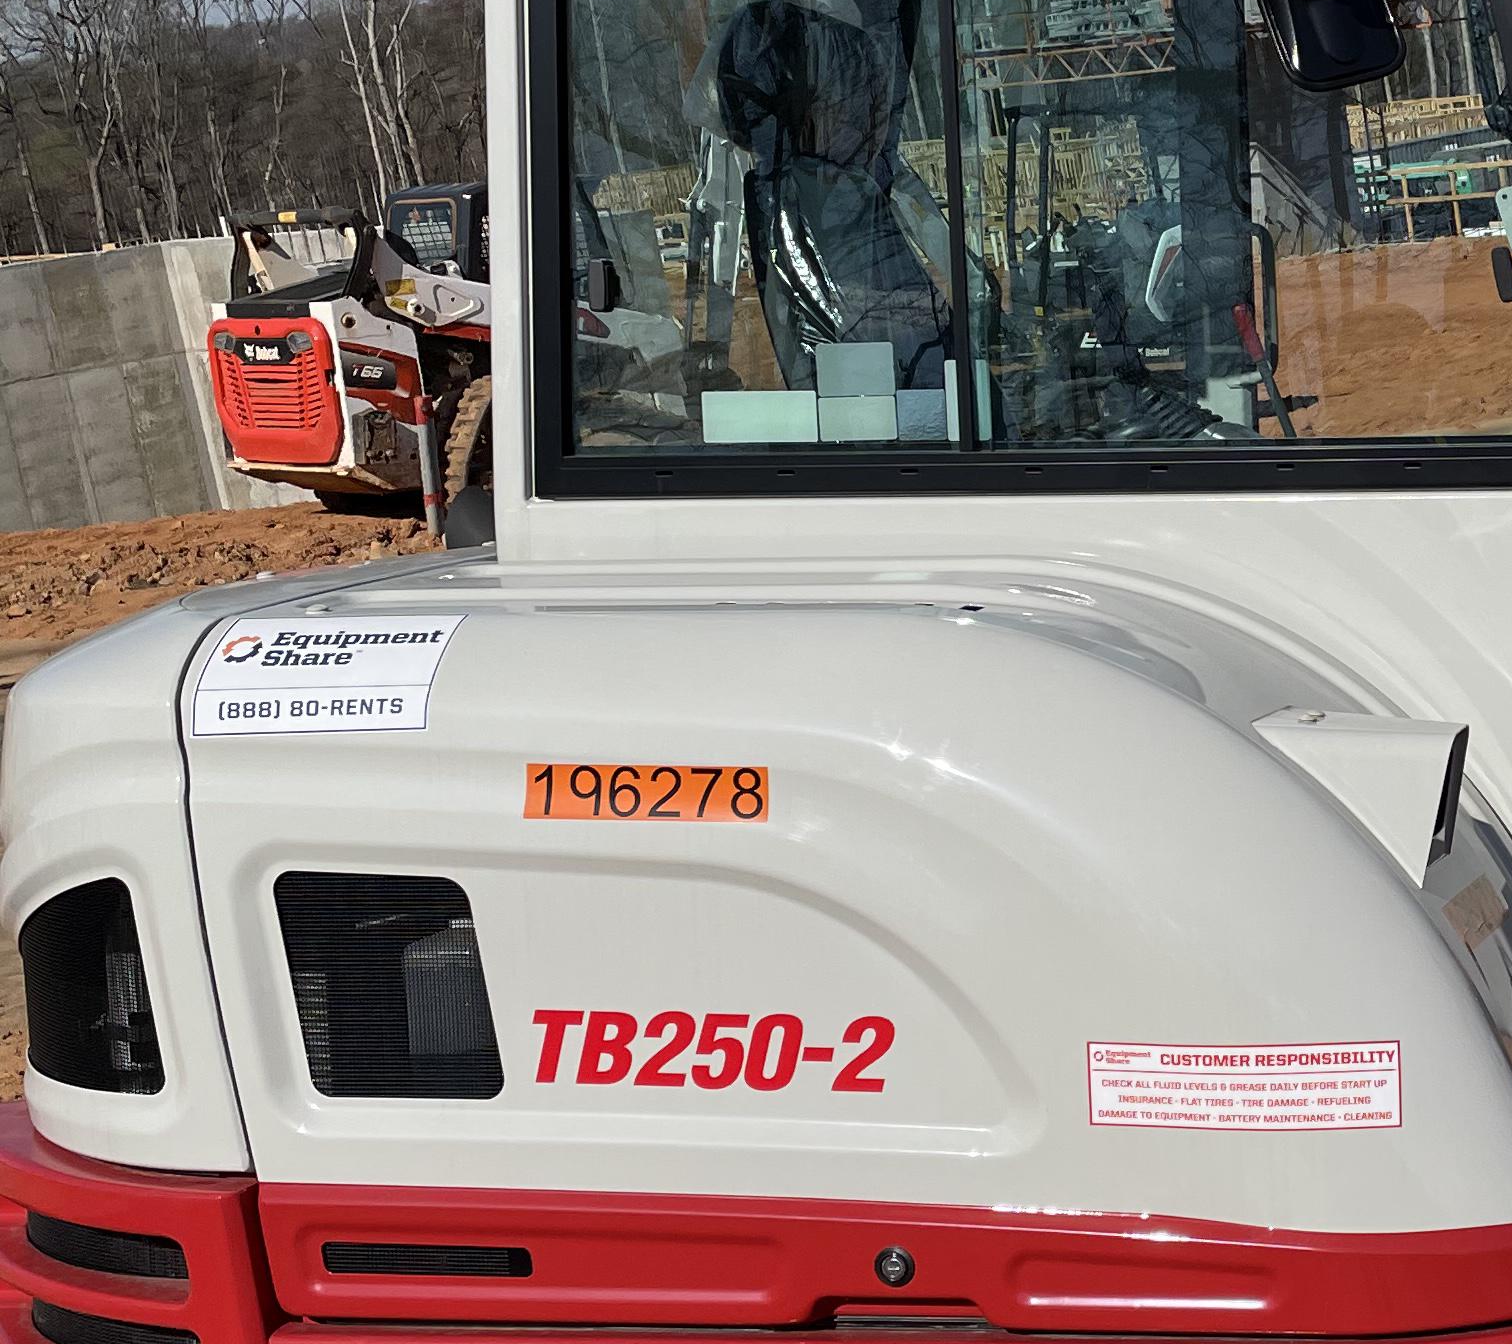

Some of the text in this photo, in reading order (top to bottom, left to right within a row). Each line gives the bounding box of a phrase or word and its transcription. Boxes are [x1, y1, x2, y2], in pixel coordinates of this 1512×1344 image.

[270, 629, 444, 650] Equipment
[261, 649, 353, 667] Share
[218, 698, 404, 721] (888) 80-RENTS
[532, 766, 764, 819] 196278
[532, 1009, 896, 1093] TB250-2
[1160, 1050, 1395, 1067] CUSTOMER RESPONSIBILITY
[1102, 1079, 1134, 1088] CHECK
[1153, 1081, 1181, 1090] FLUID
[1184, 1082, 1217, 1091] LEVELS
[1230, 1083, 1267, 1091] GREASE
[1270, 1082, 1299, 1091] DAILY
[1301, 1081, 1338, 1090] BEFORE
[1341, 1080, 1371, 1089] START
[1119, 1095, 1371, 1107] INSURANCE FLAT TIRES TIRE DAMAGE REFUELING
[1098, 1110, 1137, 1119] DAMAGE
[1140, 1111, 1152, 1119] TO
[1155, 1112, 1210, 1122] EQUIPMENT
[1264, 1114, 1335, 1123] MAINTENANCE
[1344, 1112, 1392, 1121] CLEANING
